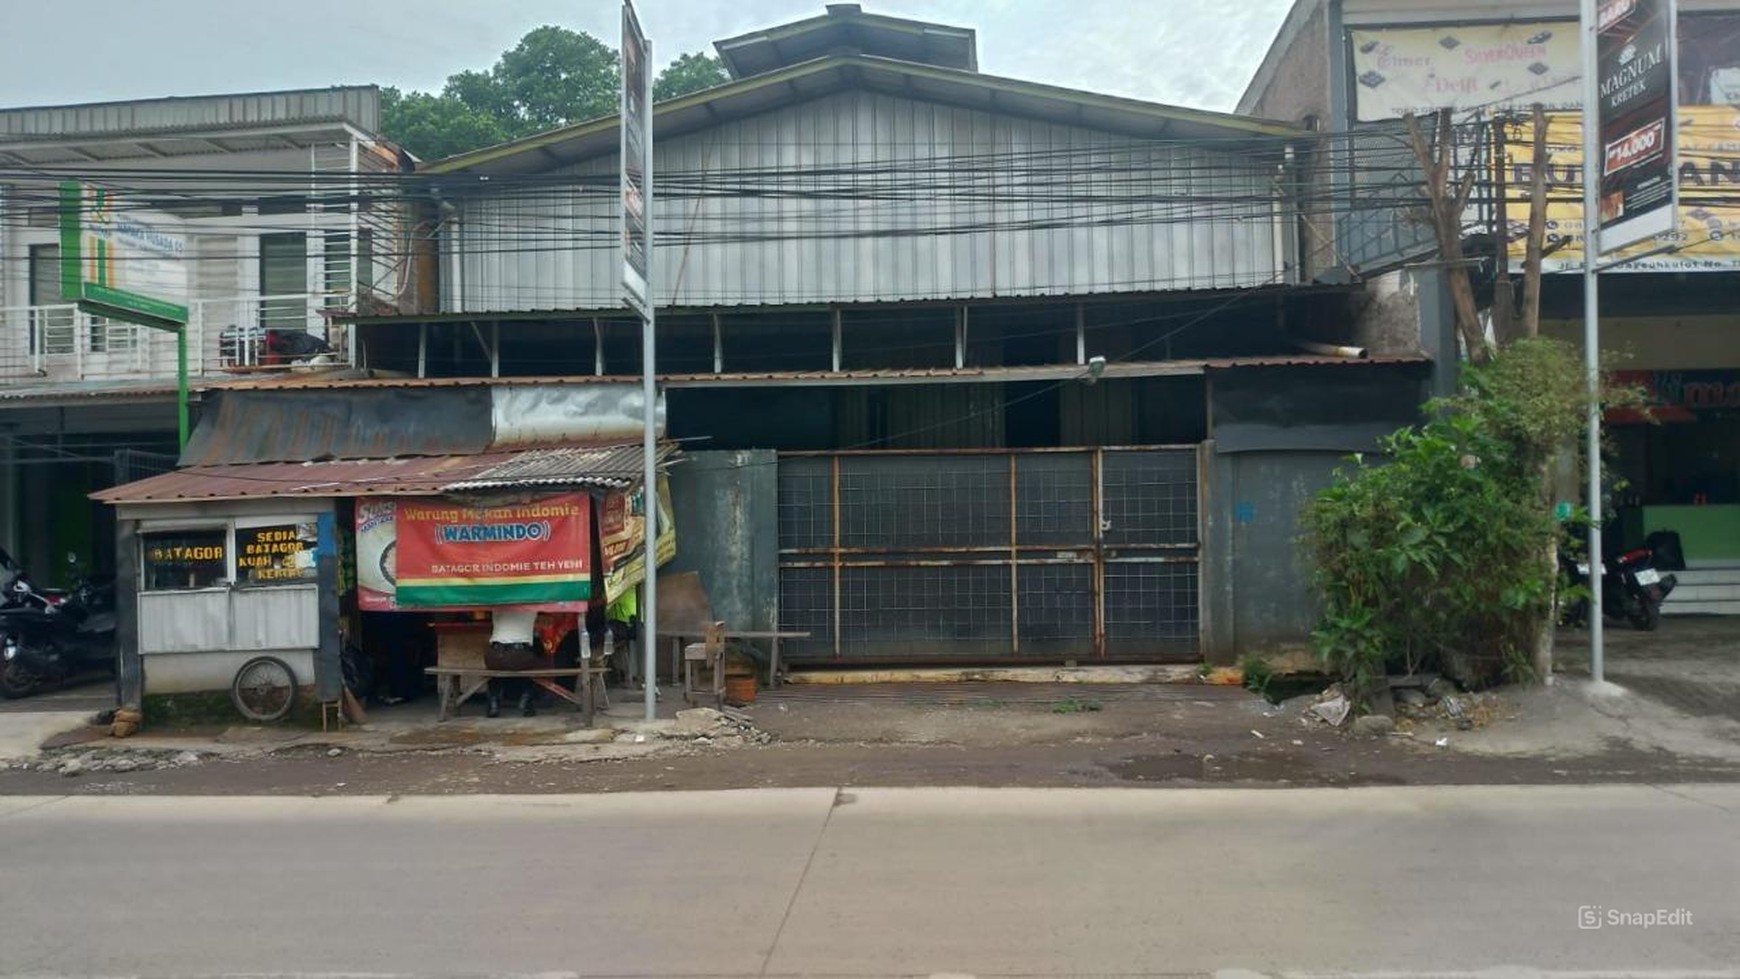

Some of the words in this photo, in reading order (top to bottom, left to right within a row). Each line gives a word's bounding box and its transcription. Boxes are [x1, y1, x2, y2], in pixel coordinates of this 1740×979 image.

[1600, 43, 1662, 98] MAGNUM
[1611, 81, 1646, 107] KRETEK
[404, 507, 458, 523] Warung
[517, 503, 580, 518] Indomie
[256, 530, 297, 542] SEDIA
[442, 523, 543, 543] WARMINDO
[153, 546, 224, 561] BATAGOR
[245, 541, 304, 554] BATAGOR
[238, 554, 272, 567] KUAH
[432, 564, 480, 574] BATAGOR
[483, 563, 530, 573] INDOMIE
[534, 561, 556, 570] TEH
